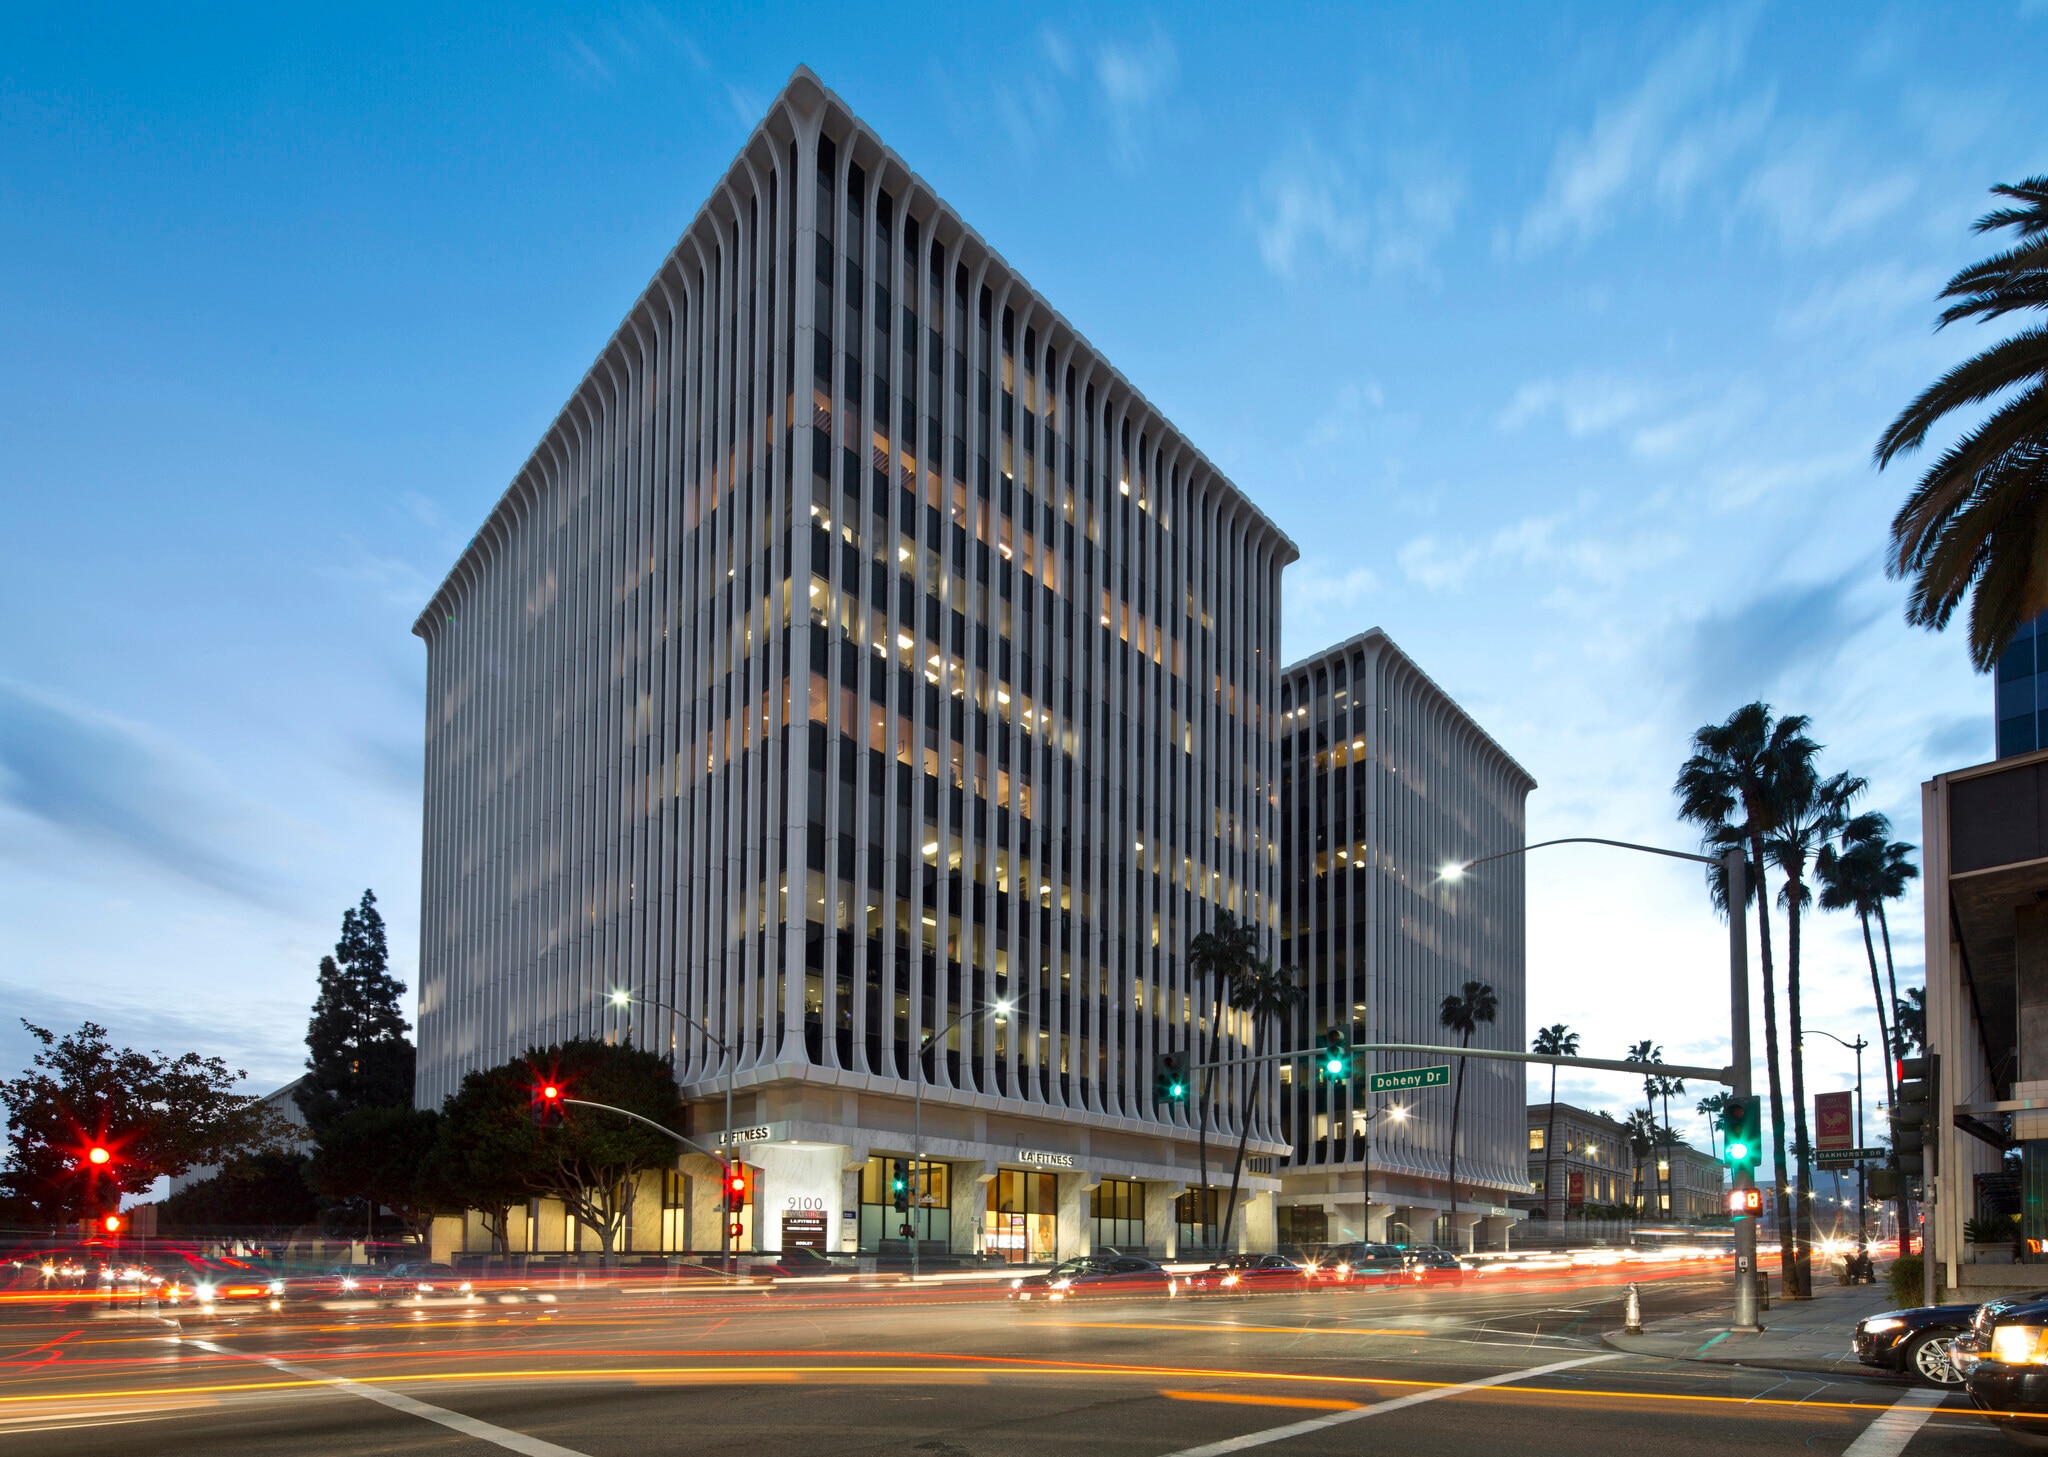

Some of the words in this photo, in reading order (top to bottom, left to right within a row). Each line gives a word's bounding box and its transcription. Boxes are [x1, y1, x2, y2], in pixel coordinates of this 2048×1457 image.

[1377, 1075, 1421, 1088] Doheny
[1427, 1072, 1441, 1082] Dr
[731, 1127, 768, 1142] FITNESS
[1036, 1153, 1074, 1166] FITNESS
[1819, 1151, 1864, 1159] OAKHURST
[787, 1196, 823, 1210] 9100
